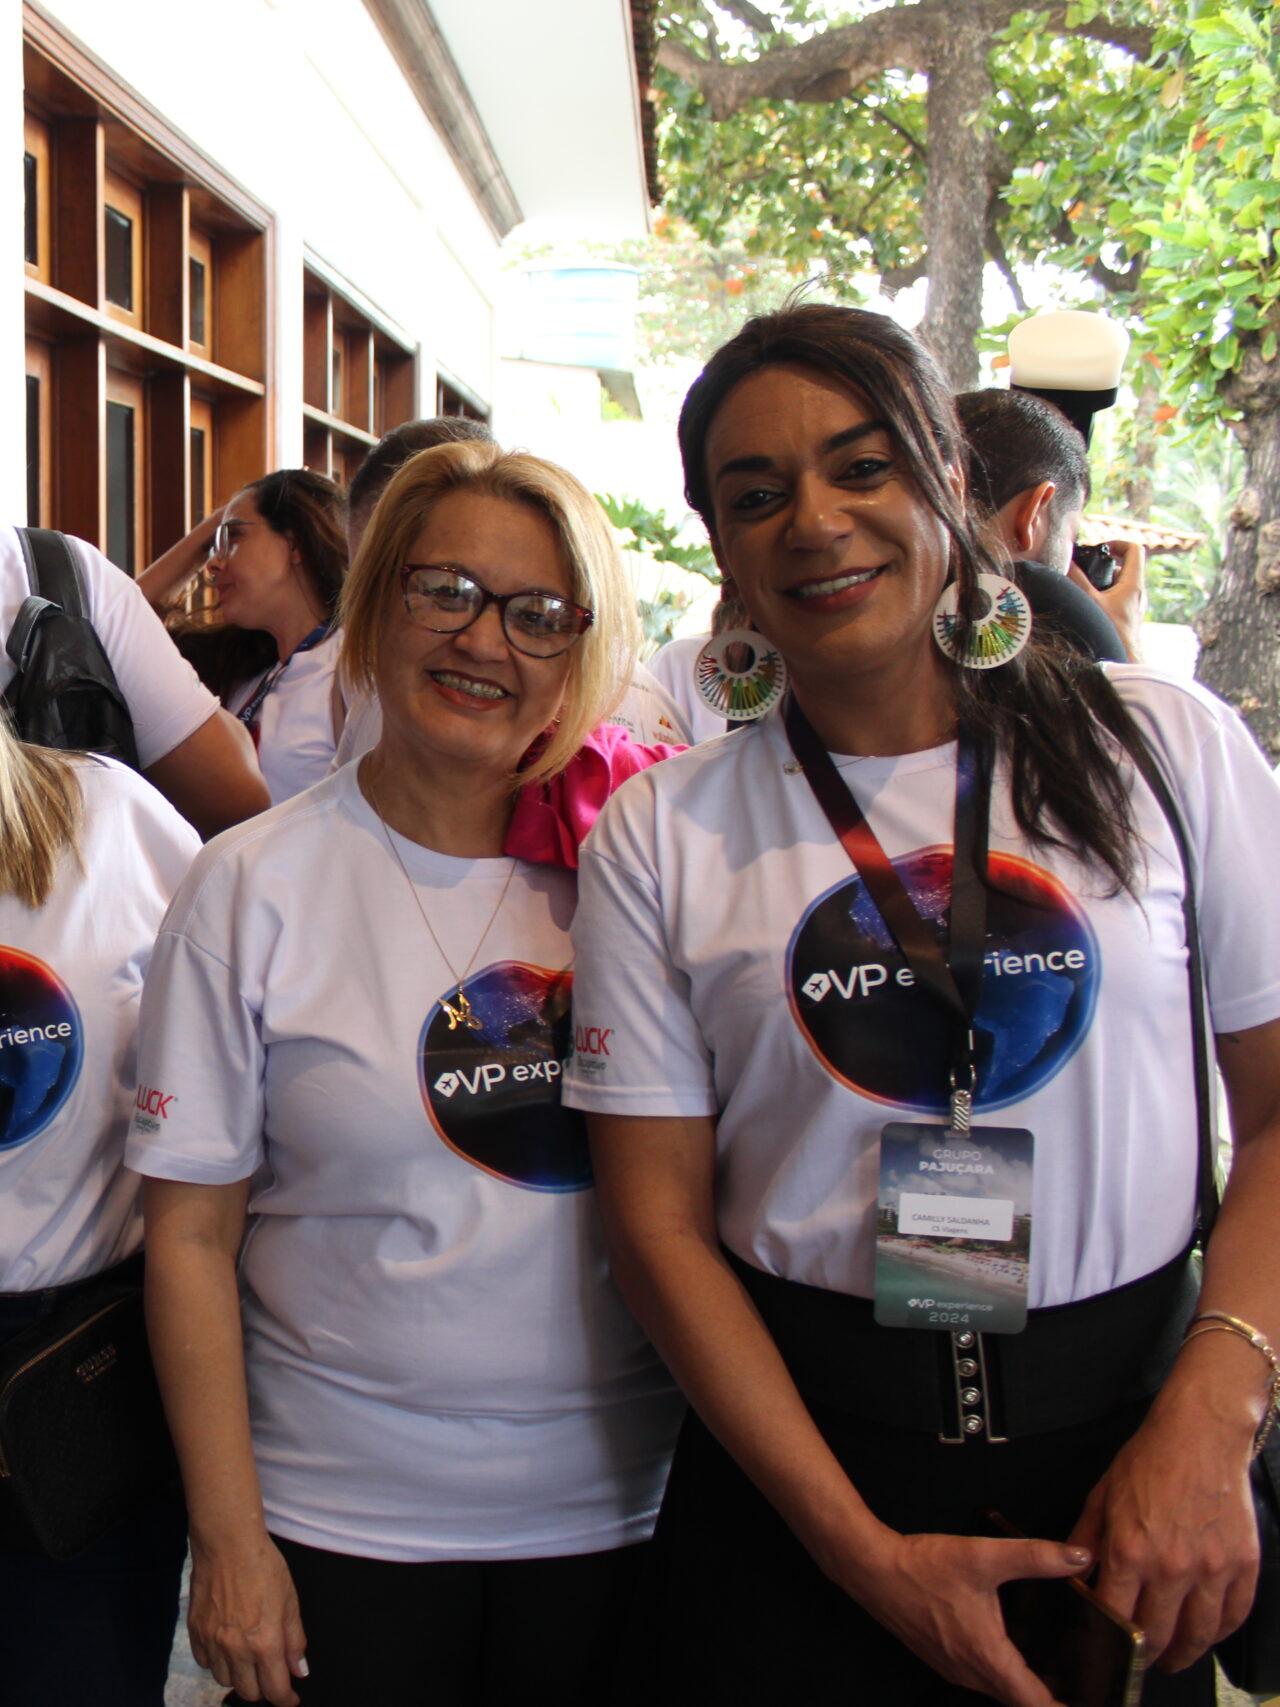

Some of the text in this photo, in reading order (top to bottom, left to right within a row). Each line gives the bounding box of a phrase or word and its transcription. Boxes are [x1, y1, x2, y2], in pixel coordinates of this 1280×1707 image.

[828, 963, 888, 1000] VP
[576, 1026, 612, 1057] LUCK
[456, 1064, 506, 1095] VP
[136, 1084, 174, 1119] LUCK
[932, 1149, 982, 1161] GRUPO
[919, 1161, 994, 1175] PAJUÇARA
[917, 1298, 994, 1312] VP experience
[928, 1311, 970, 1324] 2024
